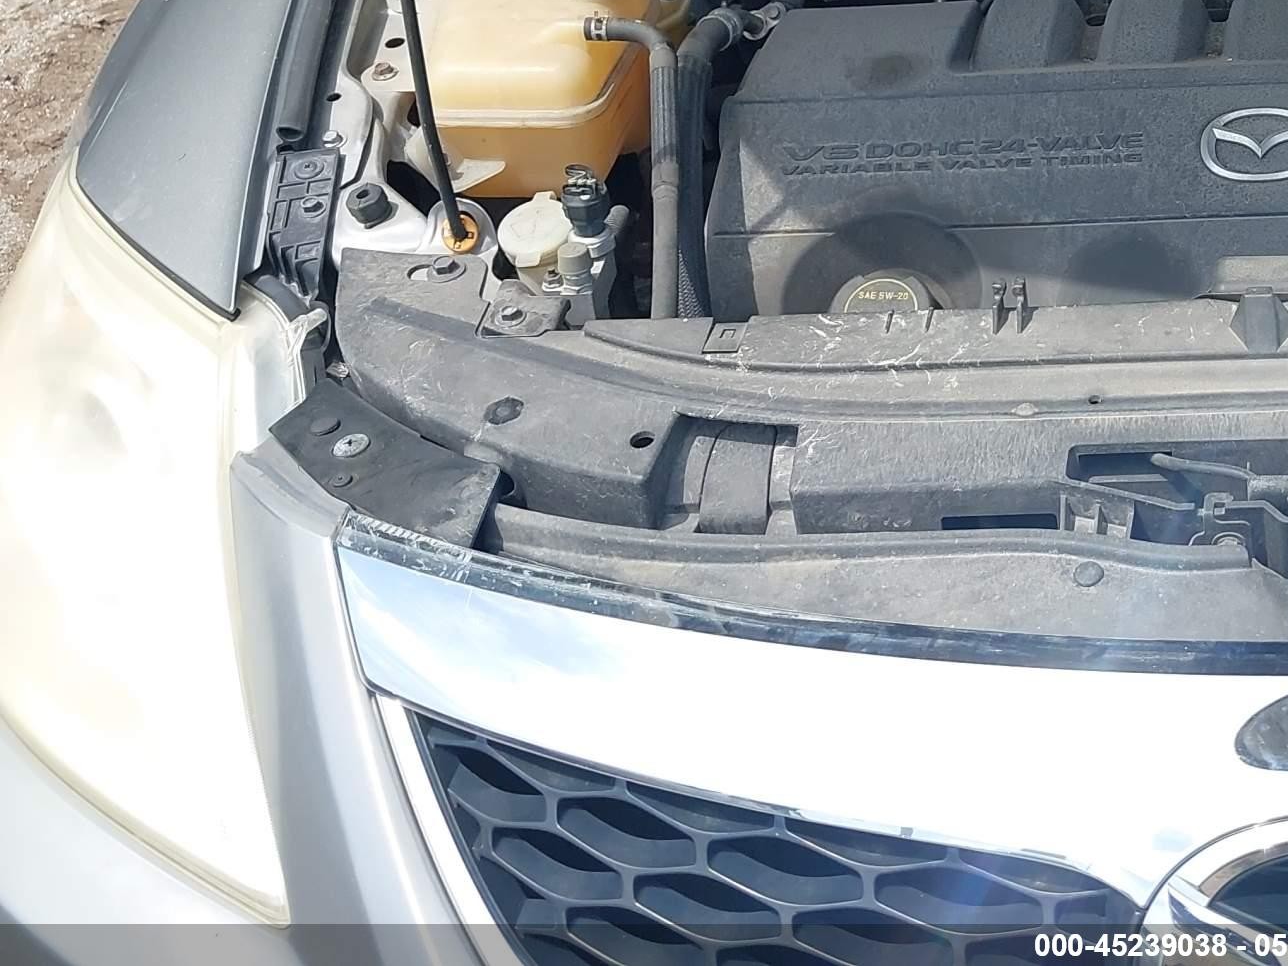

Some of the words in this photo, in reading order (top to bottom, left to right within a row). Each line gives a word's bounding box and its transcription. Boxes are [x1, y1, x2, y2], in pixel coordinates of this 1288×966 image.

[782, 142, 861, 161] V6
[865, 139, 975, 159] DOHC
[979, 132, 1144, 154] 24-VALVE
[782, 161, 933, 176] VARIABLE
[942, 155, 1033, 171] VALVE
[1039, 152, 1144, 167] TIMING
[858, 291, 877, 300] SAE
[878, 291, 909, 300] 5W-20
